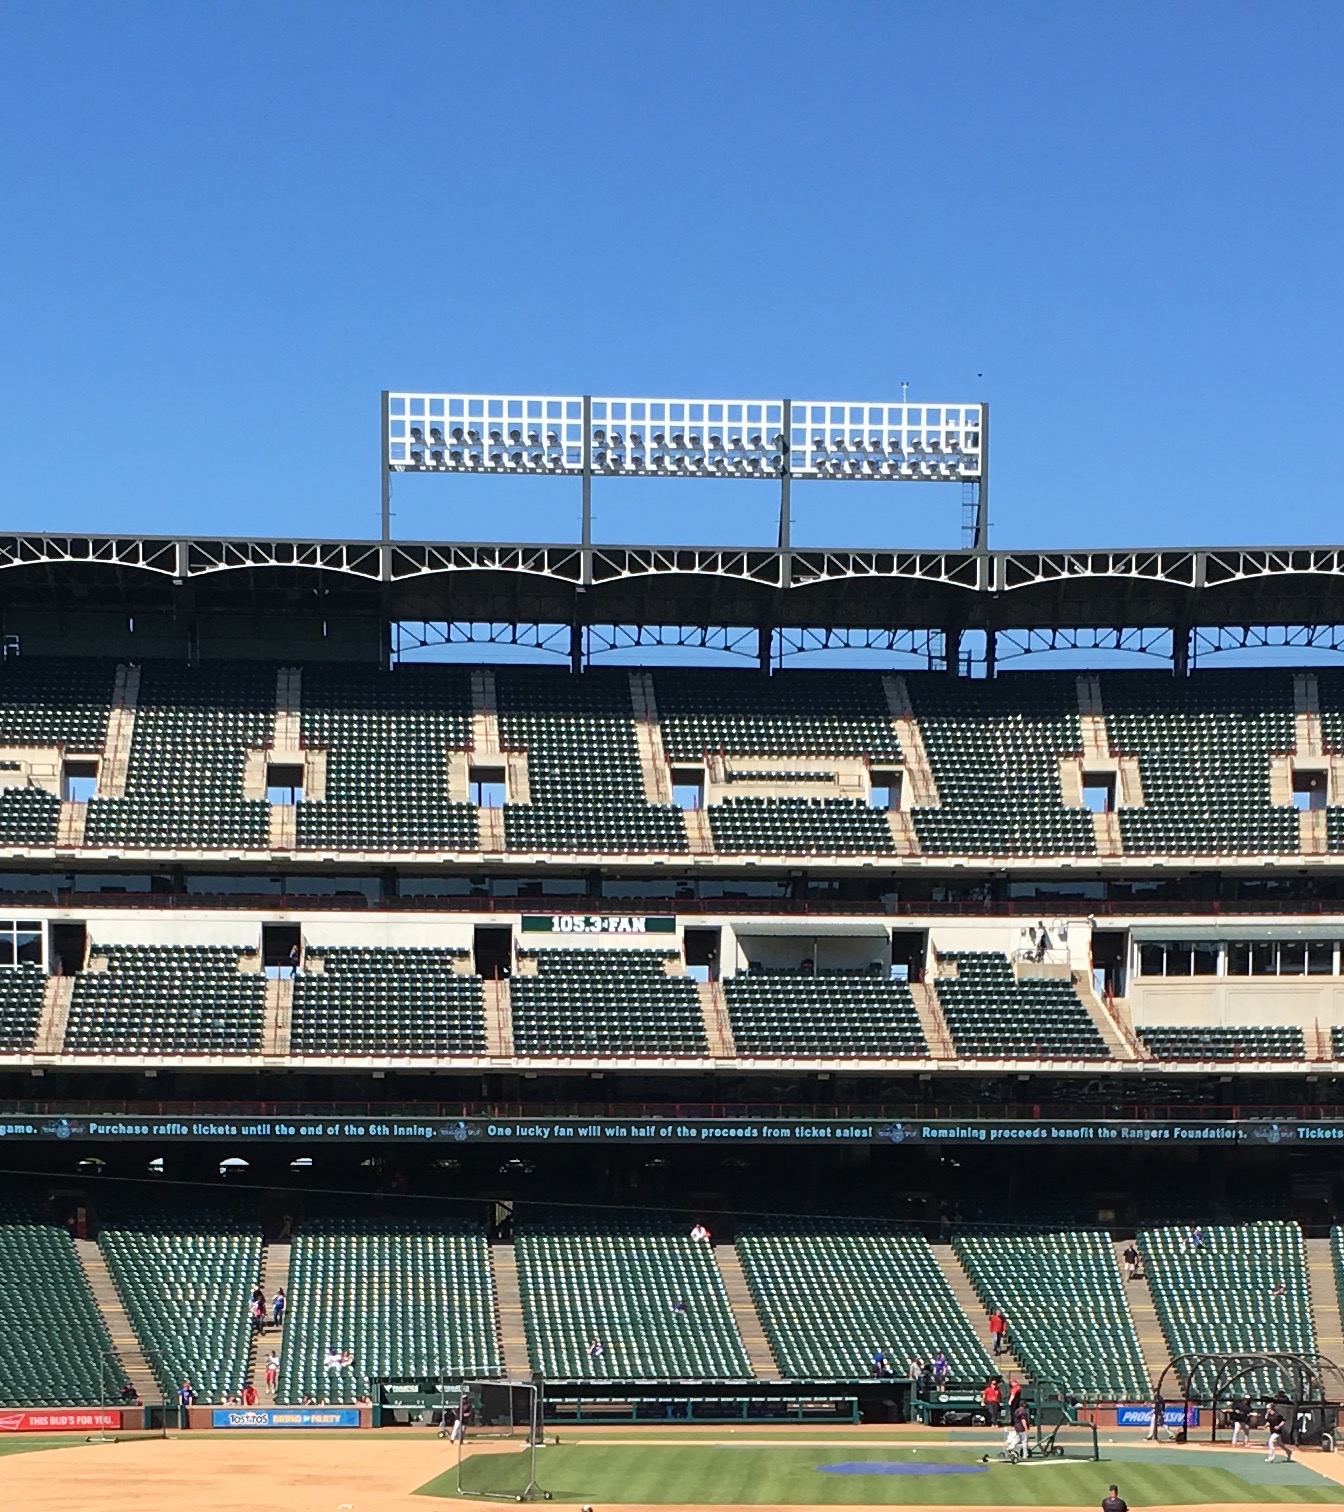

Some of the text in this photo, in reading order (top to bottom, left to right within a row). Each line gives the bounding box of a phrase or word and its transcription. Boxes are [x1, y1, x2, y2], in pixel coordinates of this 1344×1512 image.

[552, 916, 602, 932] 105.3
[608, 917, 646, 932] FAN
[89, 1123, 148, 1134] Purchase
[153, 1123, 188, 1134] raffle
[193, 1124, 238, 1134] tickets
[242, 1124, 270, 1135] until
[275, 1124, 296, 1135] the
[300, 1124, 322, 1135] end
[327, 1124, 340, 1135] of
[344, 1124, 365, 1136] the
[369, 1124, 390, 1136] 6th
[394, 1125, 437, 1138] inning.
[488, 1125, 512, 1136] One
[516, 1125, 550, 1138] lucky
[554, 1126, 574, 1136] fan
[578, 1125, 600, 1136] will
[605, 1126, 627, 1137] win
[631, 1126, 656, 1137] half
[660, 1126, 673, 1137] of
[677, 1126, 697, 1137] the
[702, 1127, 758, 1139] proceeds
[762, 1127, 790, 1138] from
[795, 1127, 832, 1138] ticket
[922, 1127, 986, 1140] Remaining
[990, 1127, 1047, 1140] proceeds
[1051, 1127, 1094, 1138] benefit
[1098, 1128, 1117, 1138] the
[1122, 1128, 1170, 1140] Rangers
[1297, 1128, 1344, 1138] Tickets
[29, 1416, 48, 1426] THIS
[50, 1416, 74, 1426] BUD'S
[76, 1416, 92, 1424] FOR
[1296, 1412, 1312, 1432] T
